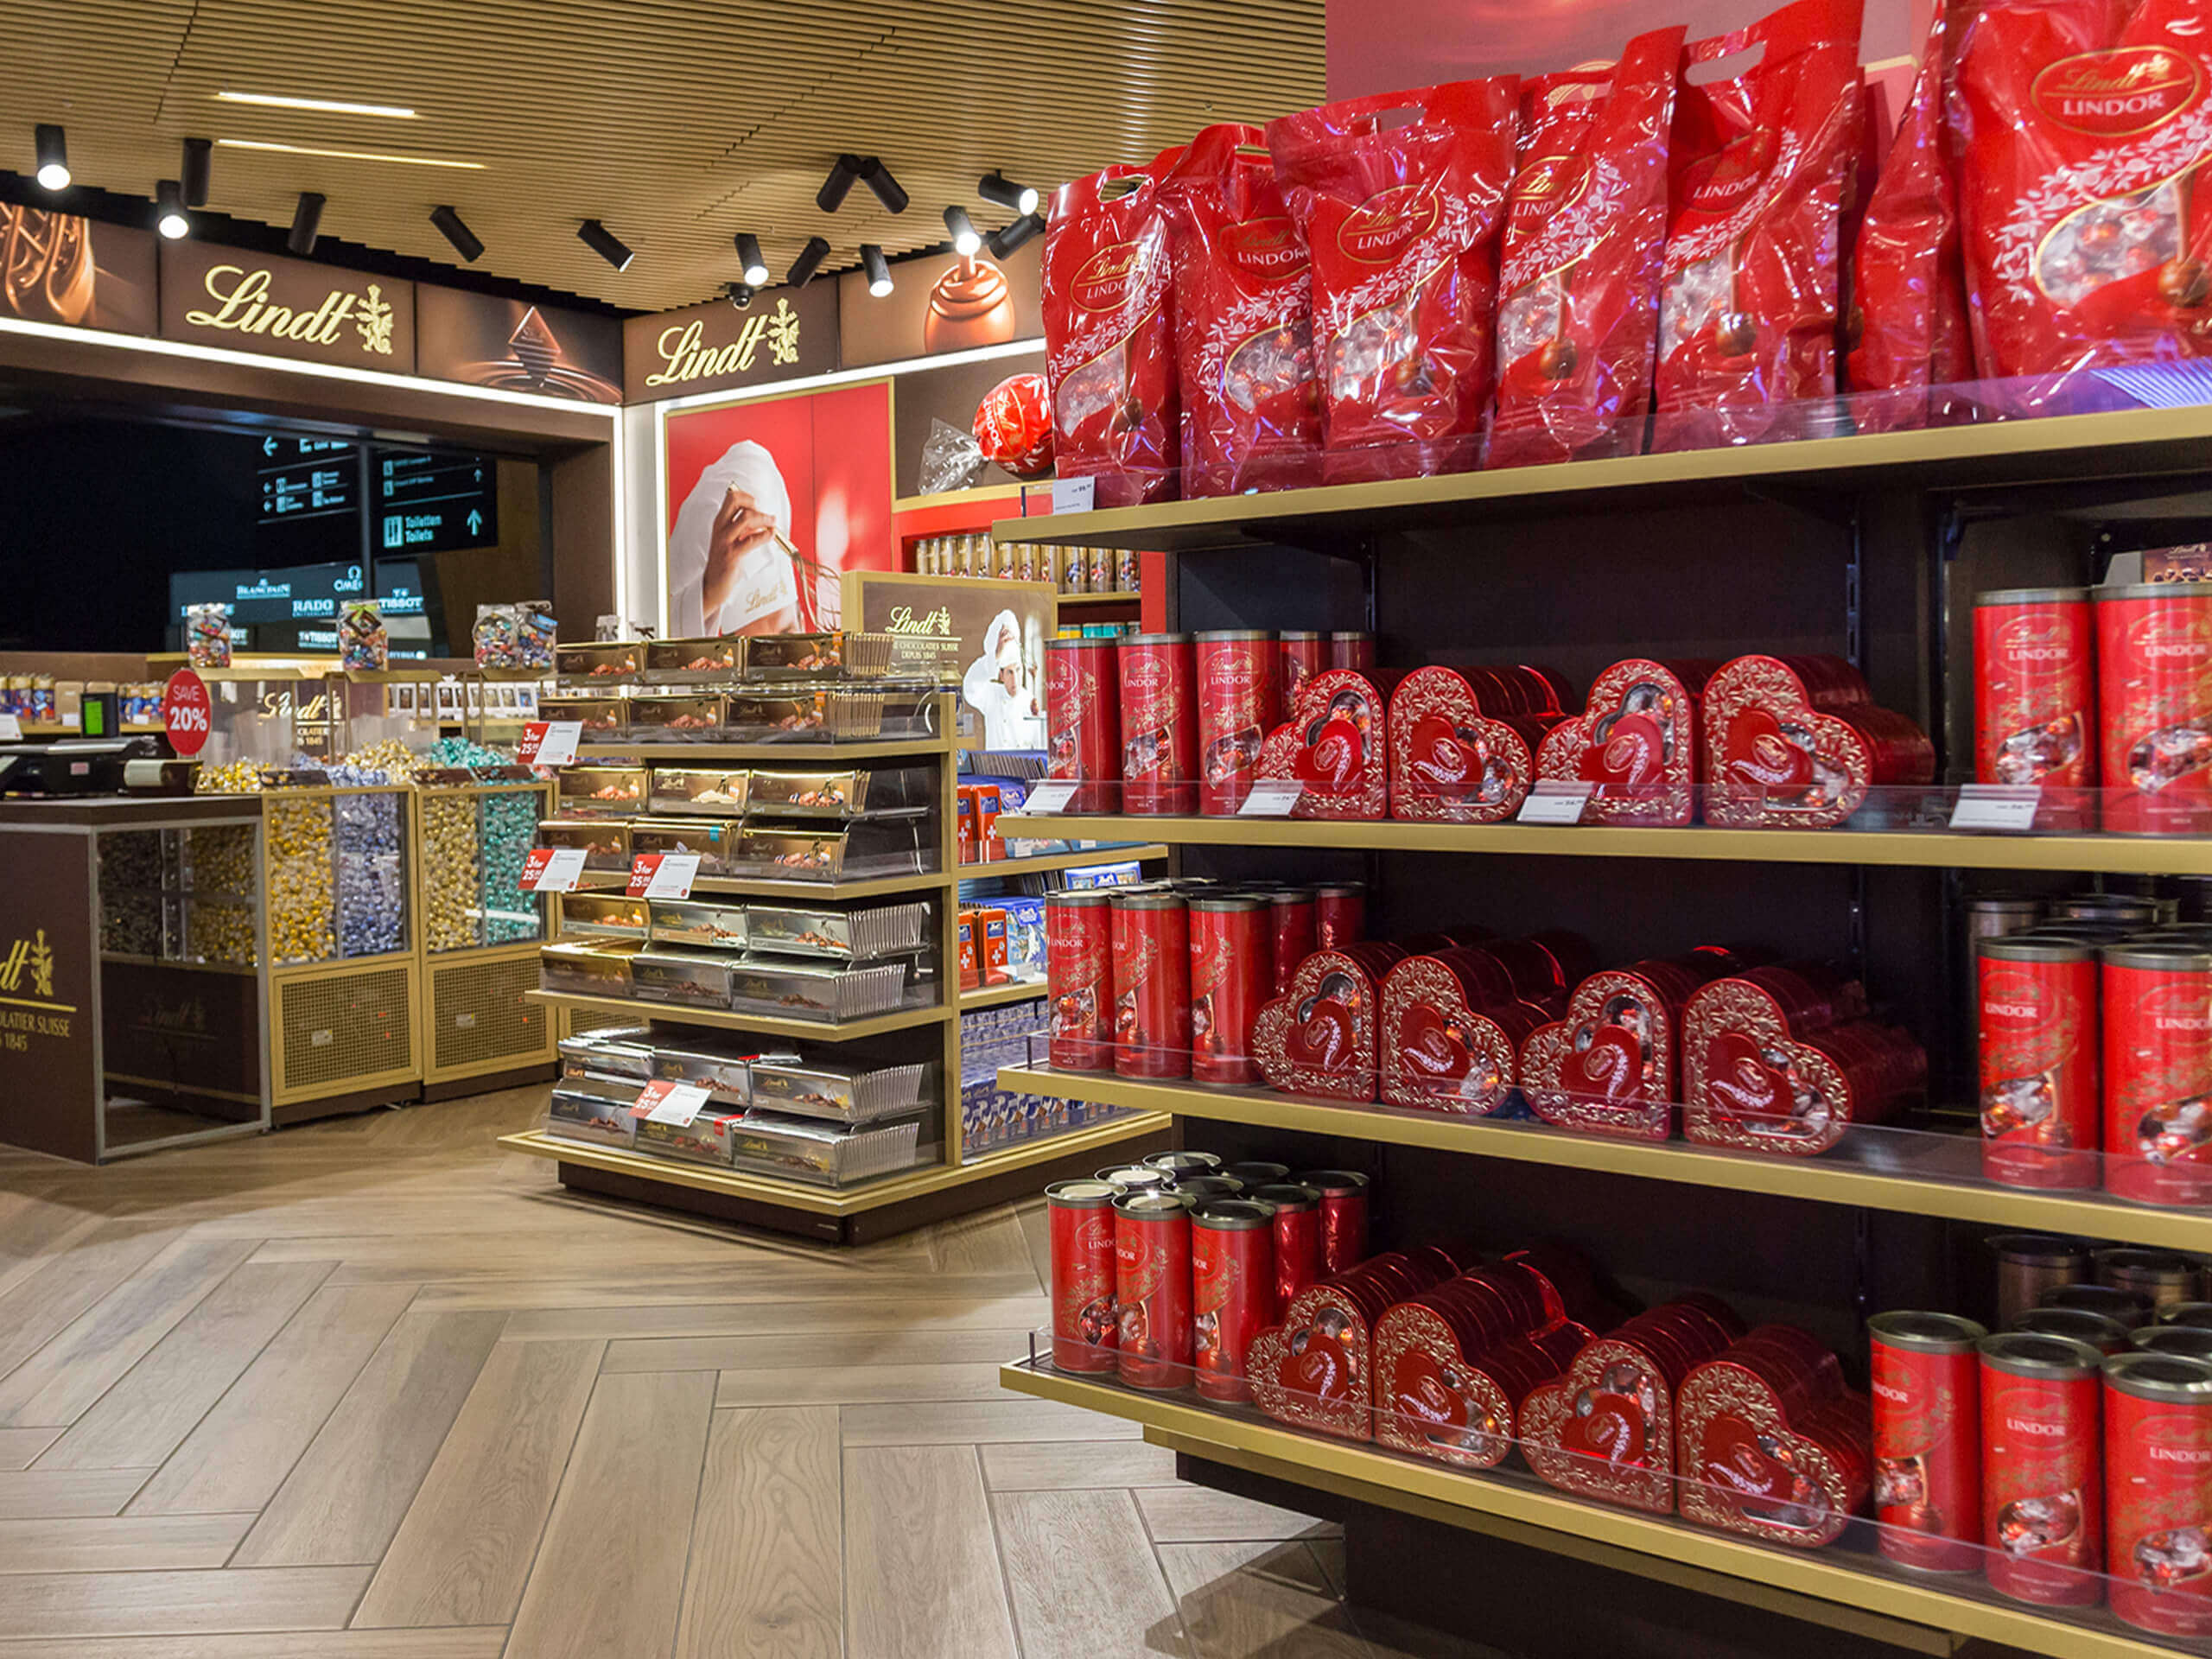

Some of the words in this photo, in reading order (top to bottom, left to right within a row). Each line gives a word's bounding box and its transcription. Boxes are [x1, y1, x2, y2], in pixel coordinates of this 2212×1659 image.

[2063, 92, 2164, 116] LINDOR
[1357, 219, 1414, 249] LINDOR
[186, 265, 357, 345] Lindt
[645, 315, 768, 386] Lindt
[292, 600, 334, 612] RADO
[884, 606, 939, 635] Lindt
[2009, 648, 2069, 660] LINDOR
[2145, 645, 2208, 657] LINDOR
[1211, 674, 1250, 685] LINDOR
[173, 685, 200, 702] SAVE
[170, 706, 208, 732] 20%
[37, 1014, 71, 1037] SUISSE
[2155, 1016, 2212, 1030] LINDO
[5, 1033, 28, 1052] 1845
[2006, 1418, 2066, 1436] LINDOR
[2150, 1447, 2211, 1462] LINDOR
